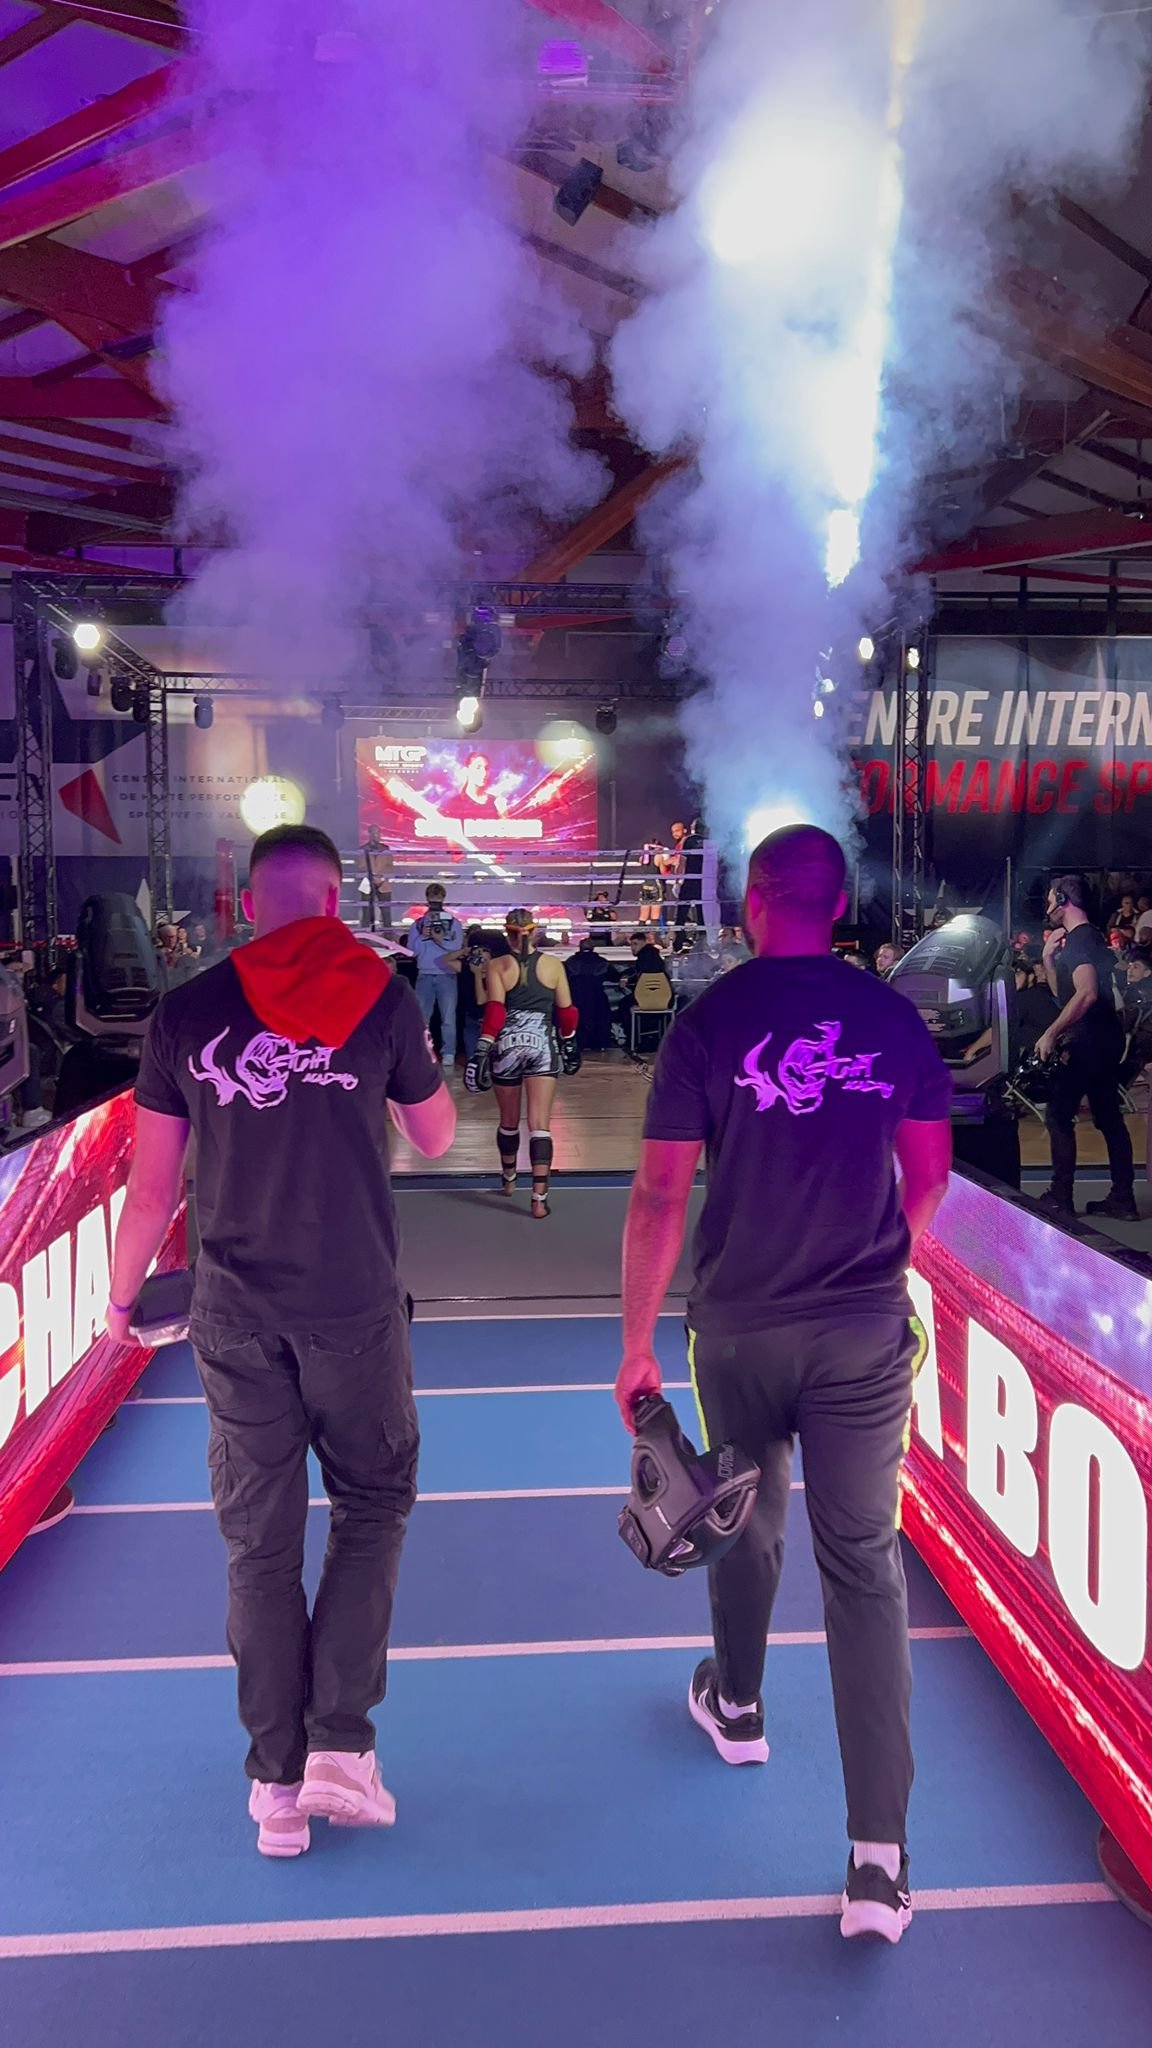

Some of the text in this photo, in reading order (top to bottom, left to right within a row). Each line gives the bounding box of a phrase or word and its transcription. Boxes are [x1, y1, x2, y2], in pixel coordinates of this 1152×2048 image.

[994, 690, 1152, 746] INTERN
[112, 774, 167, 783] CENT
[852, 759, 1088, 815] ORMANCE
[120, 792, 136, 801] DE
